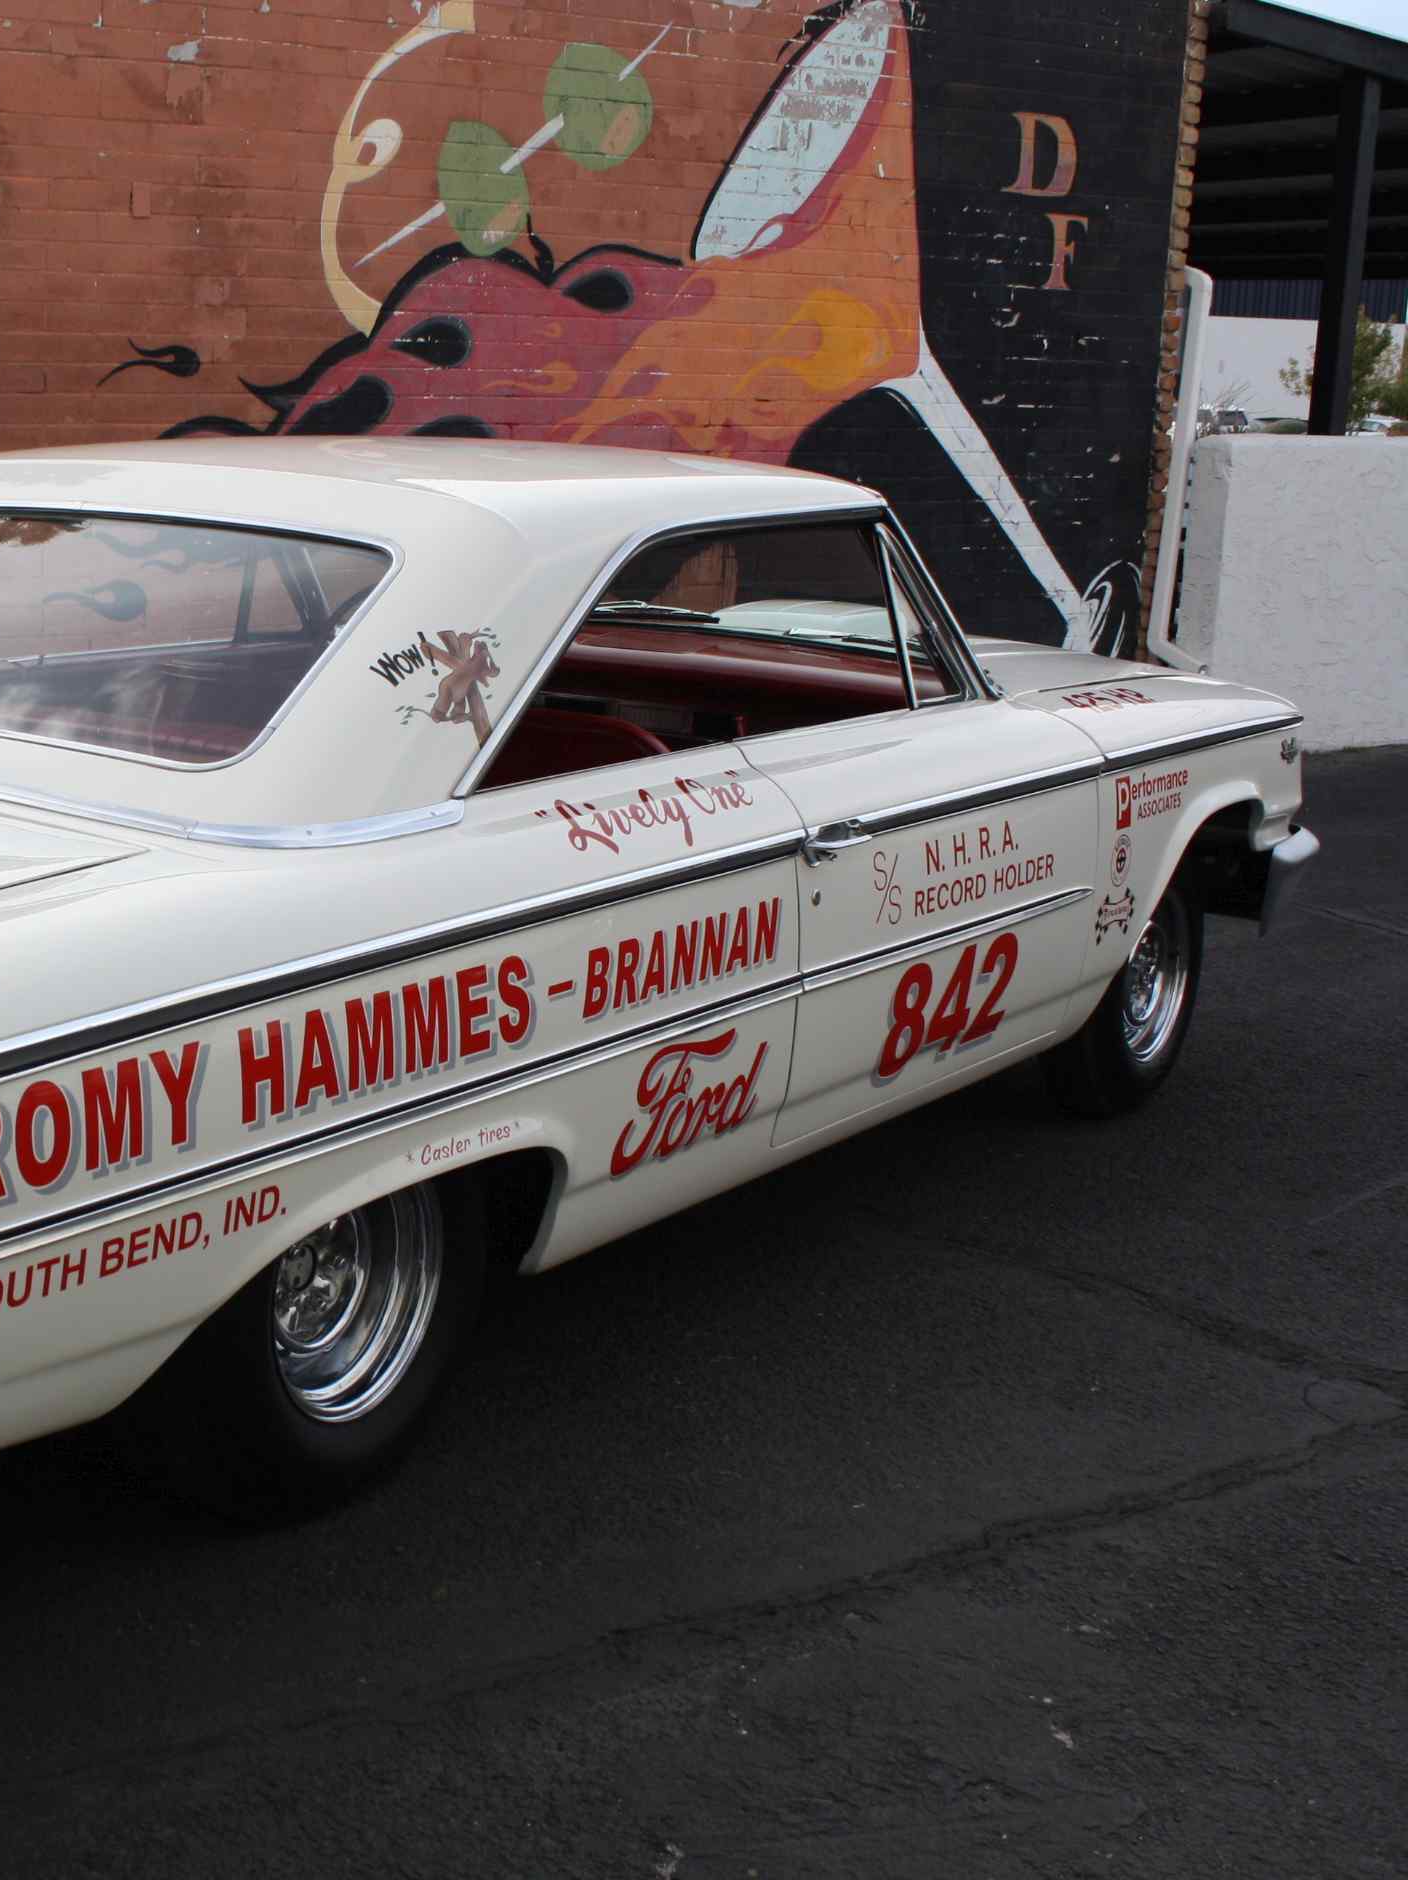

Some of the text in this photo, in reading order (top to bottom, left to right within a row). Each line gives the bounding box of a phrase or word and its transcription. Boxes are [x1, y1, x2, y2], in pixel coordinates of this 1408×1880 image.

[1001, 112, 1077, 197] D
[1042, 213, 1089, 290] F
[1137, 792, 1182, 820] ASSOCIATES
[914, 853, 1055, 917] RECORD HOLDER
[238, 955, 532, 1127] HAMMES
[583, 896, 782, 1020] BRANNAN
[878, 931, 1020, 1078] 842
[610, 1027, 769, 1178] Ford
[99, 1211, 211, 1279] BEND,
[223, 1185, 288, 1237] IND.
